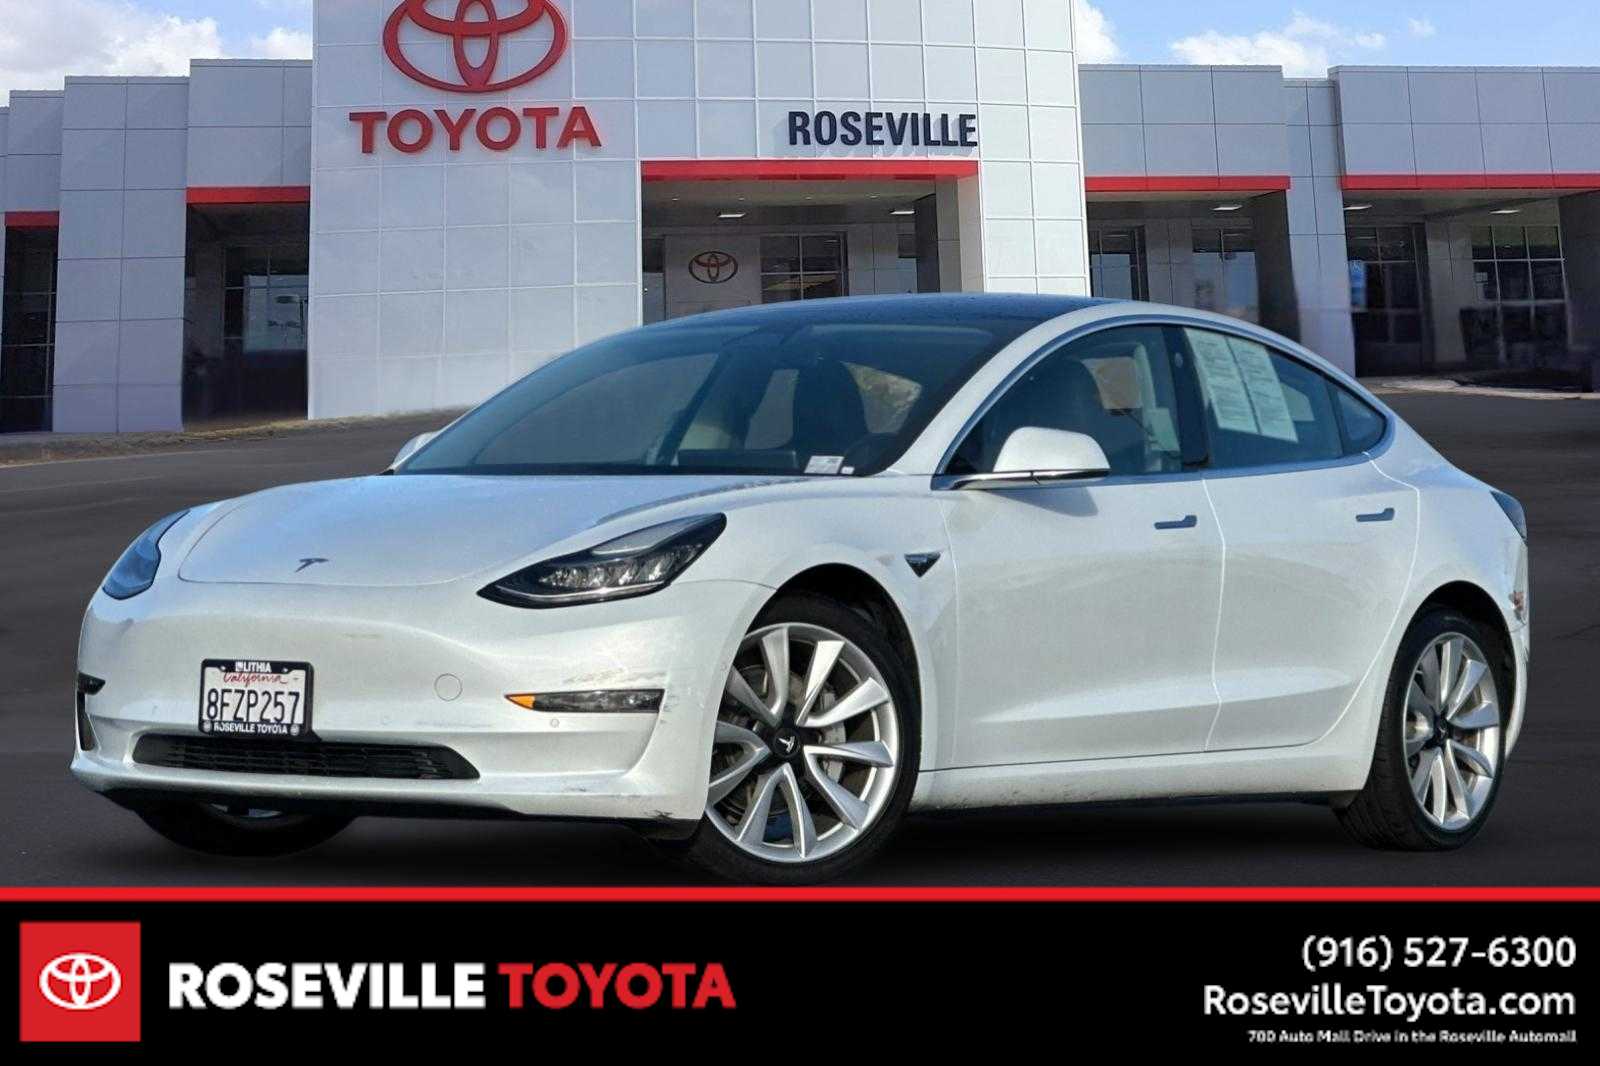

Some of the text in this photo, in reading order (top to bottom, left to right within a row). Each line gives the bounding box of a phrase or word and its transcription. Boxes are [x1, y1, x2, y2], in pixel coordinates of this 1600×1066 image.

[349, 106, 602, 154] TOYOTA
[788, 110, 979, 147] ROSEVILLE
[243, 662, 272, 672] LITHIA
[206, 688, 300, 722] 8FZP257
[213, 722, 288, 735] ROSEVILLE TOYOTA
